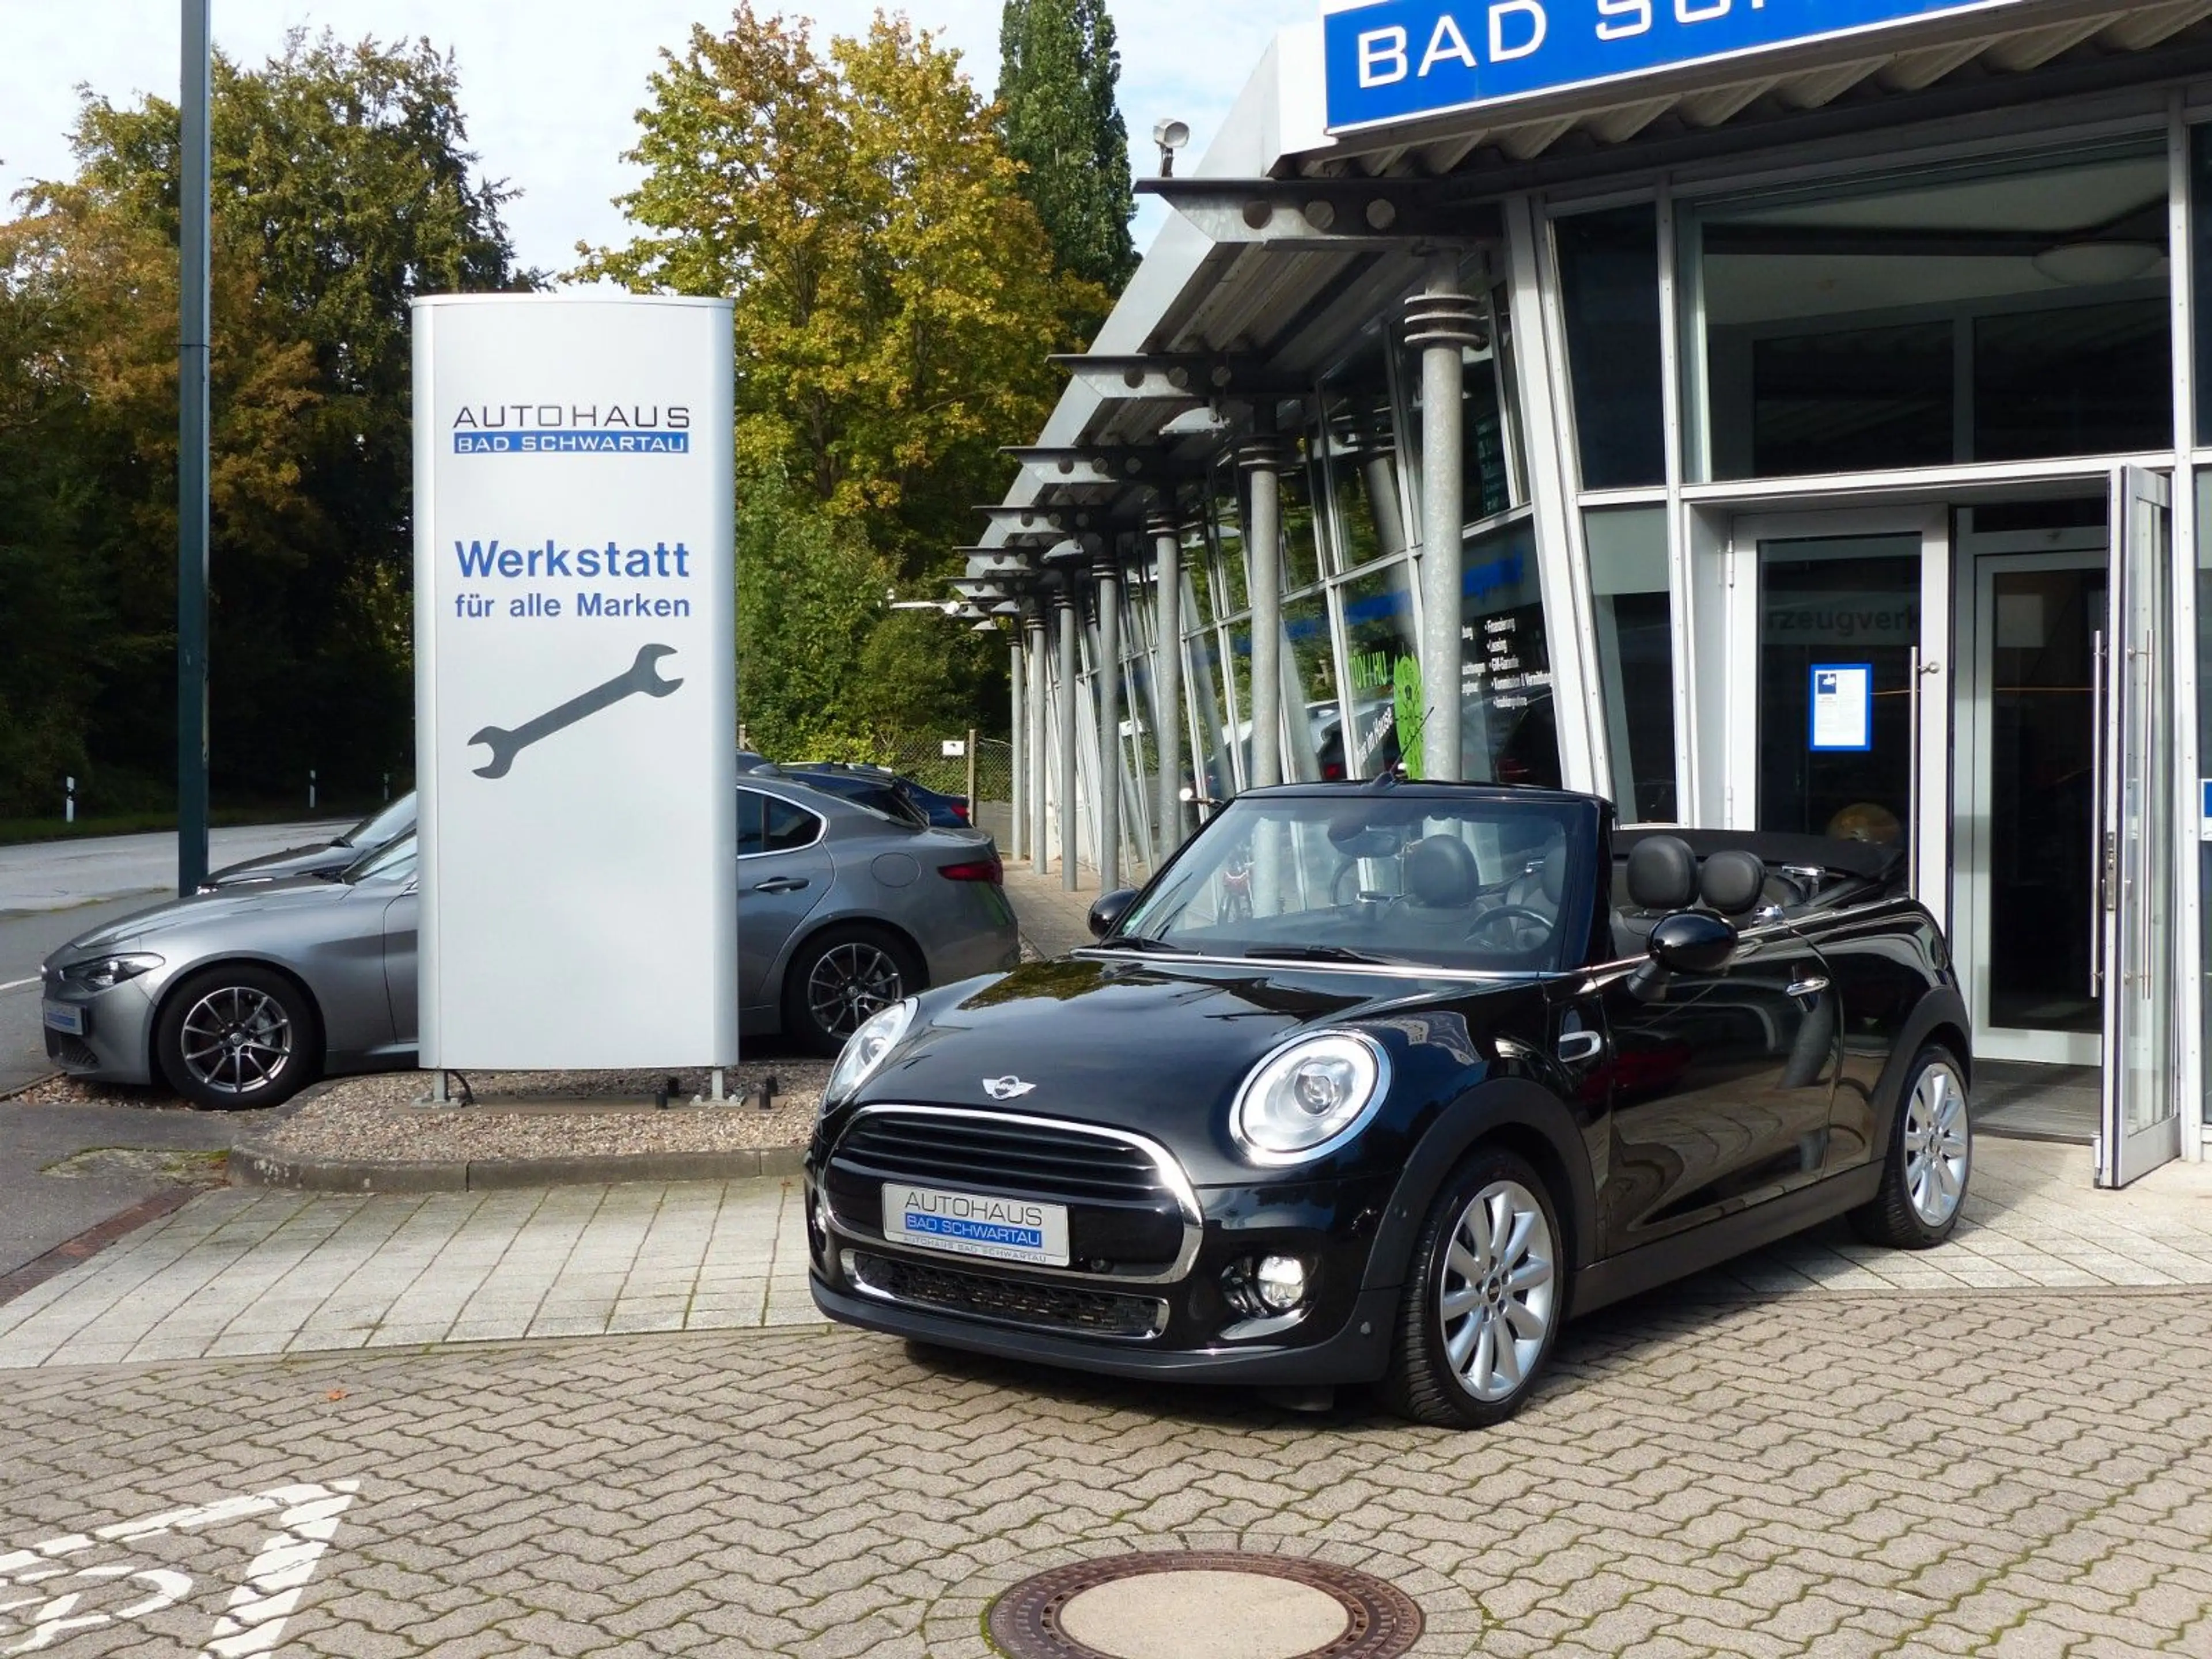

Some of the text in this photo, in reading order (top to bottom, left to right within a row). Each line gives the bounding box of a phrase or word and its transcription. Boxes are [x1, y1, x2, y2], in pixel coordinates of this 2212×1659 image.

[1358, 0, 1546, 88] BAD
[453, 404, 690, 429] AUTOHAUS
[458, 436, 684, 452] BAD SCHWARTAU
[454, 539, 690, 578] Werkstatt
[455, 593, 690, 618] für alle Marken
[905, 1191, 1042, 1226] AUTOHAUS
[907, 1215, 1040, 1245] BAD SCHWARTAU
[905, 1237, 1047, 1263] AUTOHAUS BAD SCHWARTAU
